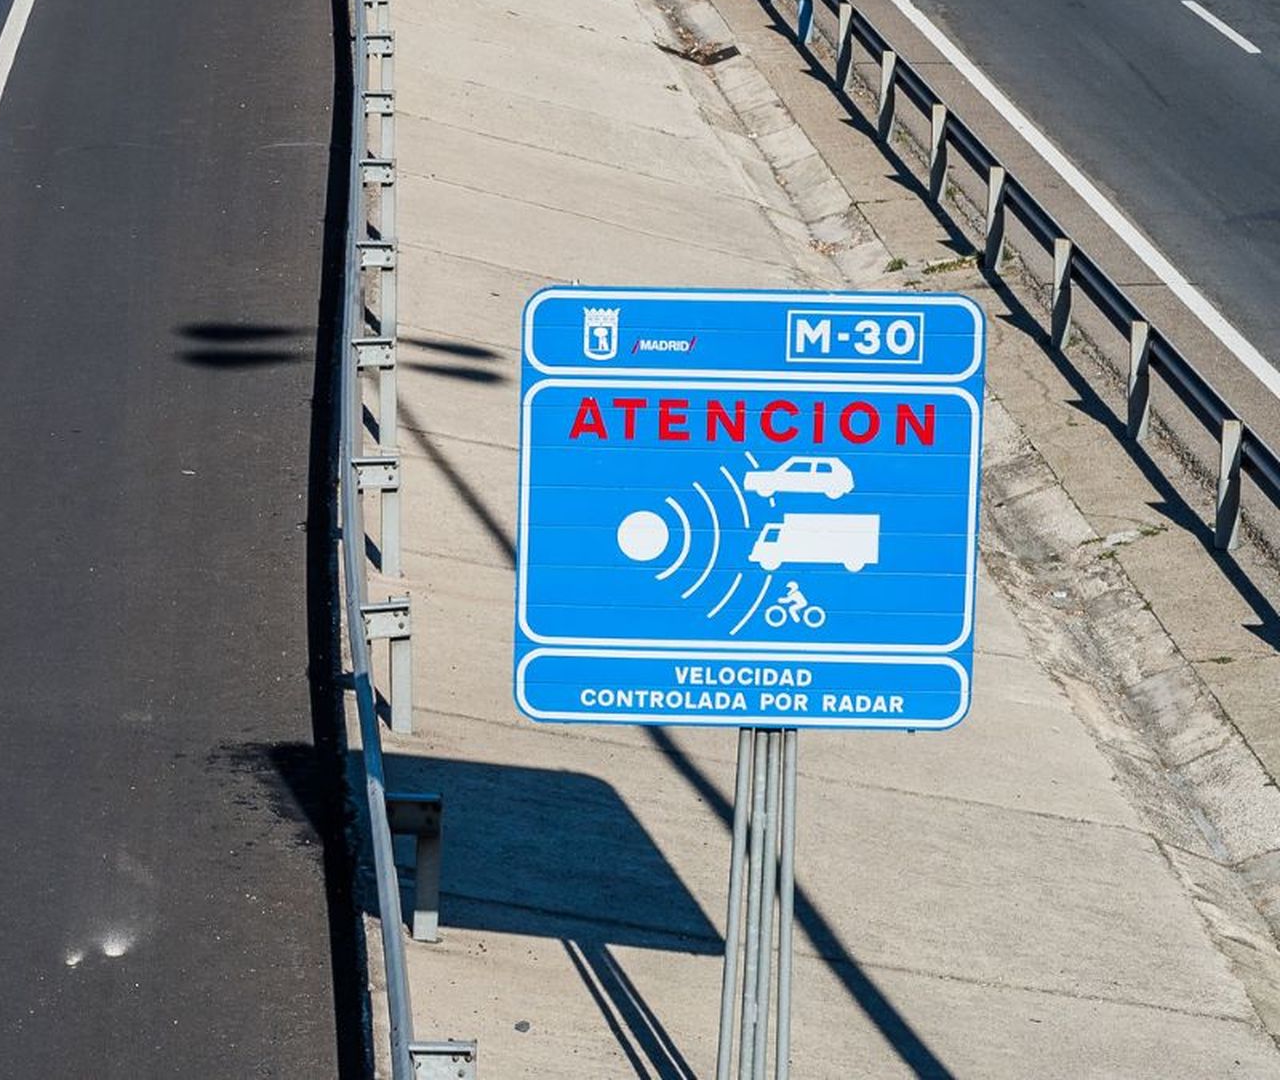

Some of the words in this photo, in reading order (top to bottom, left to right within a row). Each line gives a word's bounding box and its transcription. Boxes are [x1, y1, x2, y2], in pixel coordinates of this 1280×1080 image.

[795, 319, 915, 355] M-30
[568, 396, 935, 446] ATENCION
[675, 666, 812, 687] VELOCIDAD
[580, 688, 747, 710] CONTROLADA
[760, 692, 808, 711] POR
[822, 693, 904, 713] RADAR
